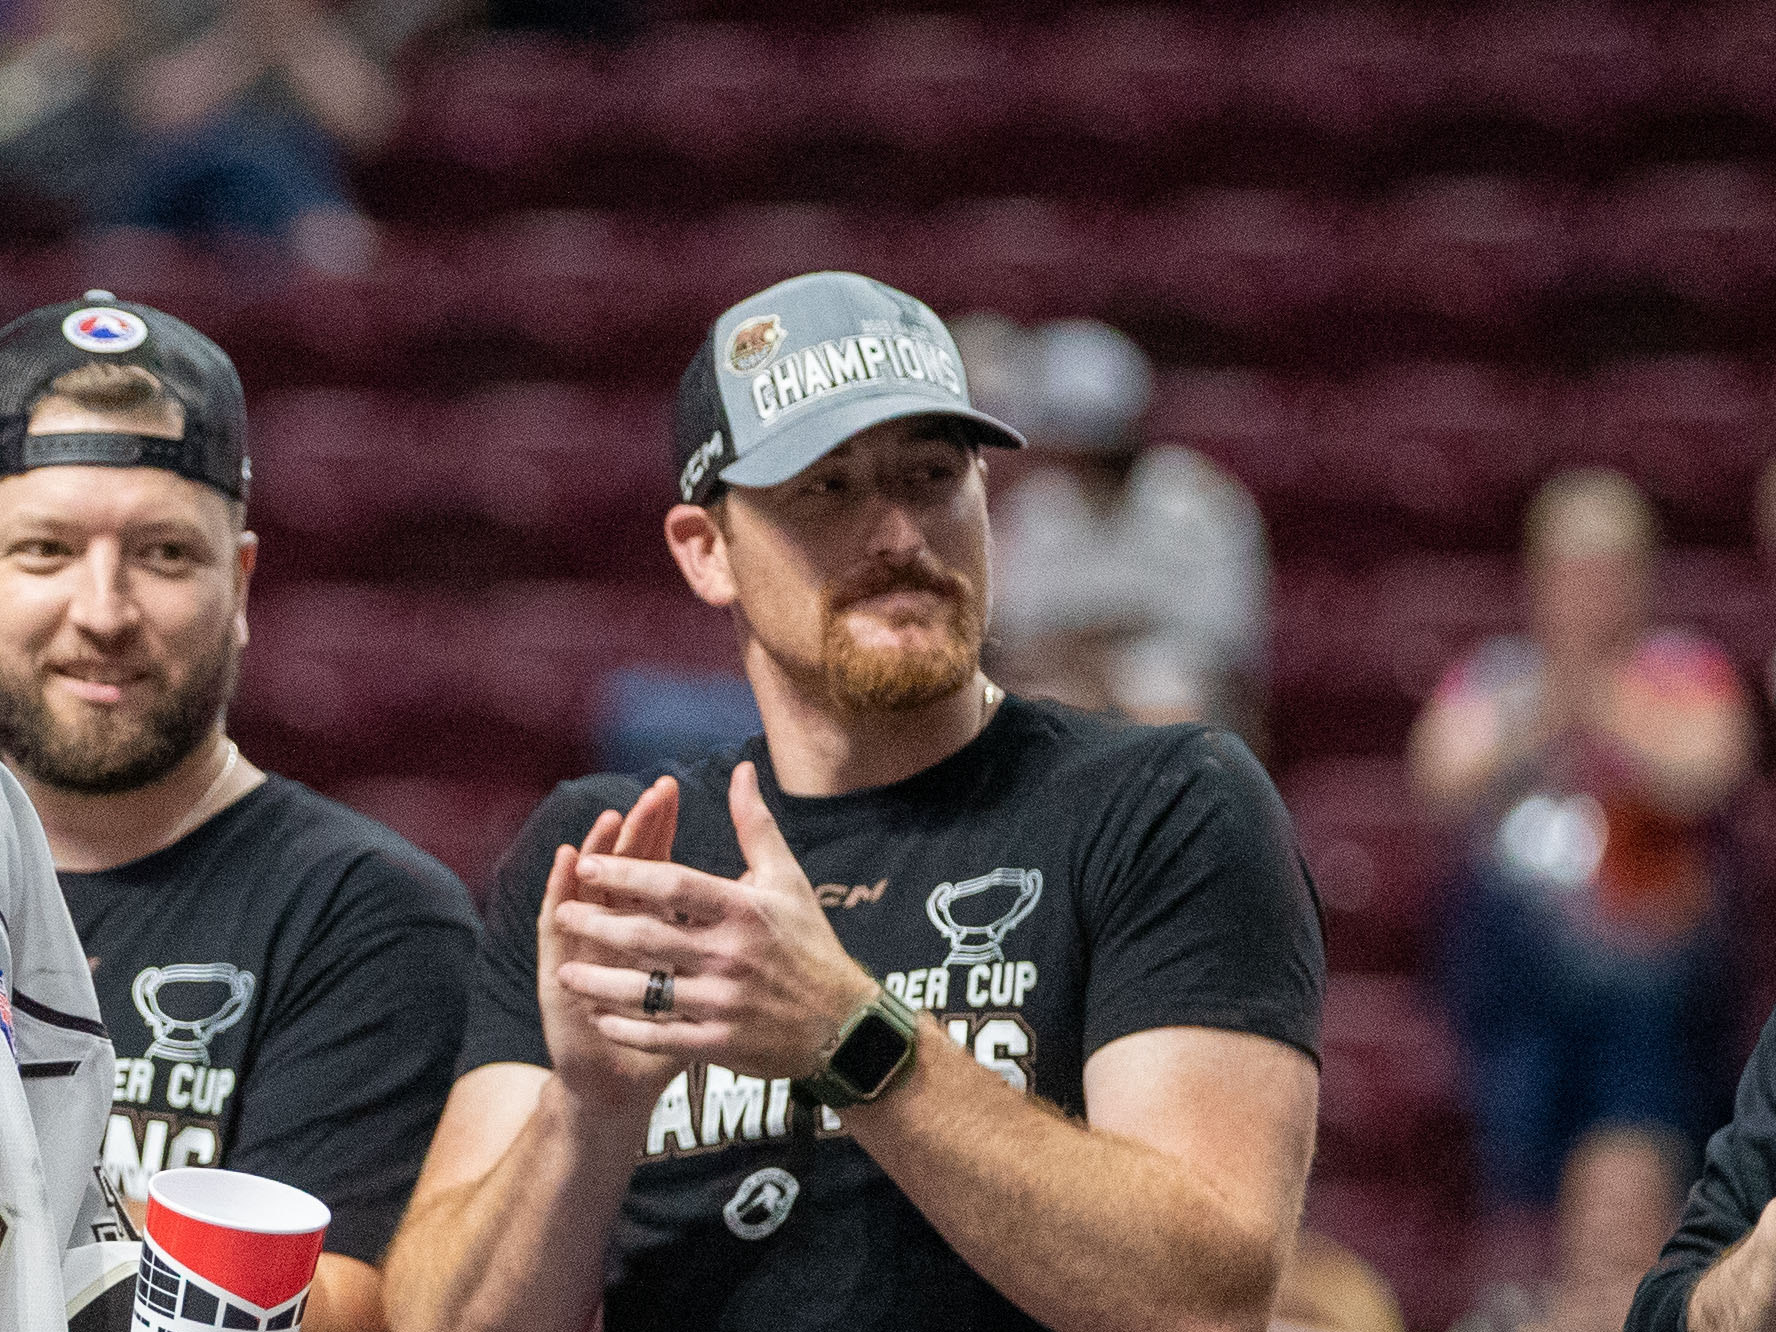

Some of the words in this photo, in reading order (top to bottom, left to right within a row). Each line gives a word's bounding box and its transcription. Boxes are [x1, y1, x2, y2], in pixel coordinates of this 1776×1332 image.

[752, 335, 962, 421] CHAMPIONS
[966, 960, 1038, 1008] CUP
[166, 1062, 236, 1116] CUP
